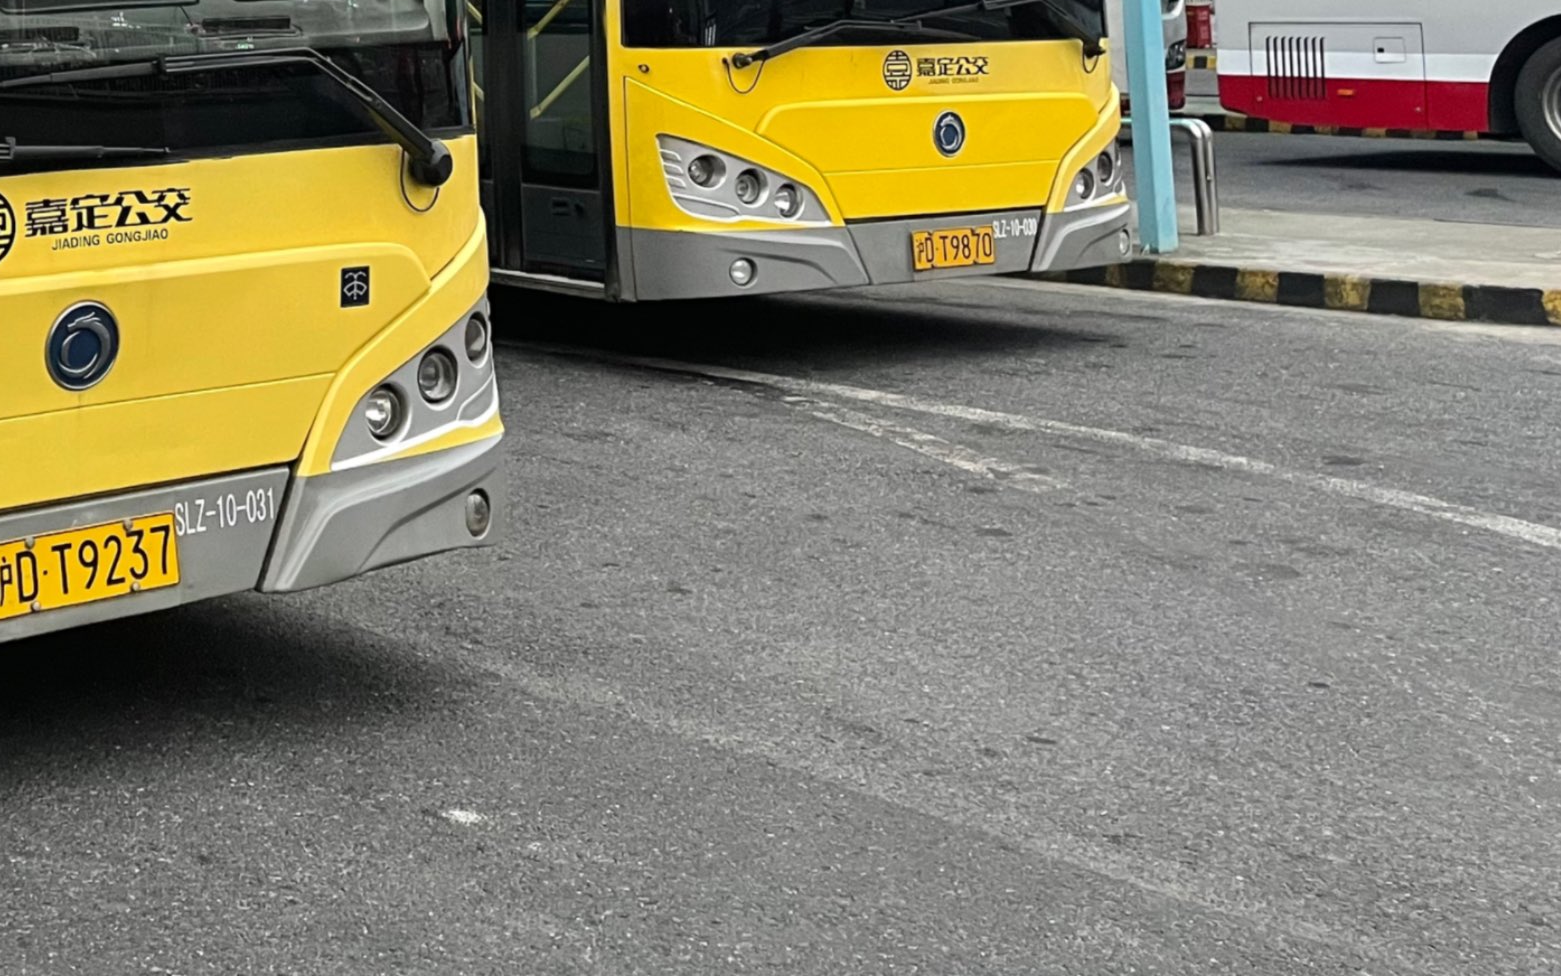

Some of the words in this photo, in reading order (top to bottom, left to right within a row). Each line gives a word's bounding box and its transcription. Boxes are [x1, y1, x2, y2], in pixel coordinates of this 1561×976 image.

[916, 56, 989, 77] 嘉定公交
[24, 187, 193, 238] 嘉定公交
[51, 235, 100, 251] JIADING
[106, 228, 169, 244] GONGJIAO
[174, 487, 274, 536] SLZ-10-031
